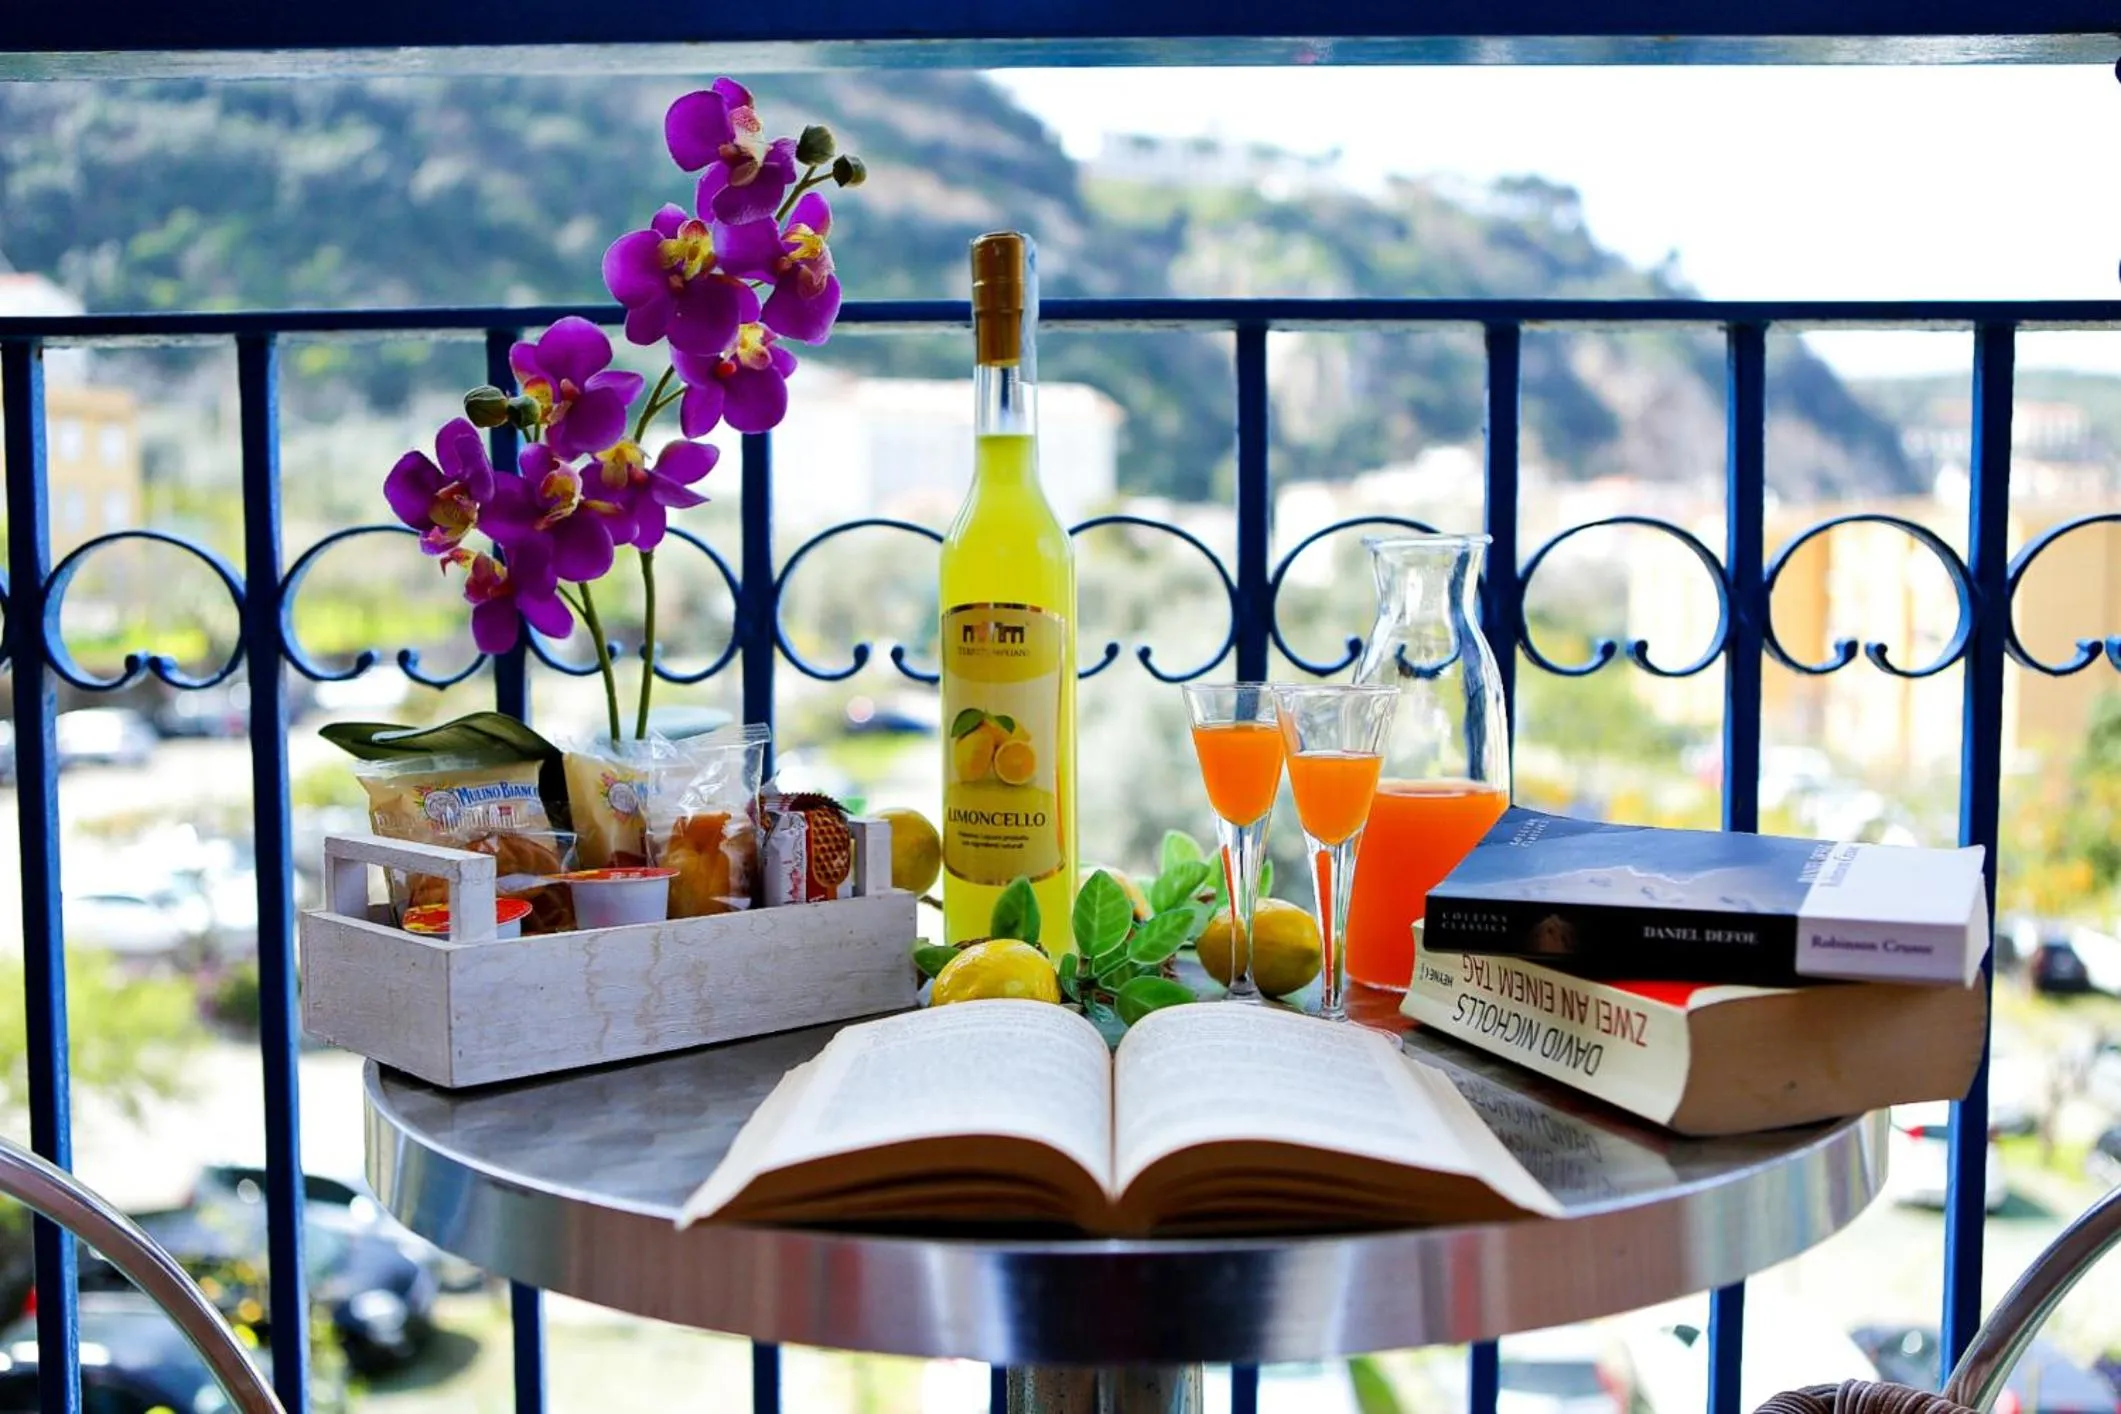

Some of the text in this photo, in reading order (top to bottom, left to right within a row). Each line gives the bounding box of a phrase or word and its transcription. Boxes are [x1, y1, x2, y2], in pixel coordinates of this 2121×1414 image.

[457, 786, 500, 805] MULINO
[947, 806, 1046, 828] LIMONCELLO
[1441, 911, 1508, 923] COLLINS
[1441, 920, 1507, 933] CLASSICS
[1643, 925, 1759, 945] DANIEL DEFOE
[1810, 934, 1935, 955] Robinson Crusoe
[1462, 952, 1494, 991] TAG
[1498, 964, 1554, 1014] EINEM
[1562, 987, 1588, 1026] AN
[1595, 998, 1648, 1048] ZWEI
[1452, 993, 1604, 1077] DAVID NICHOLLS
